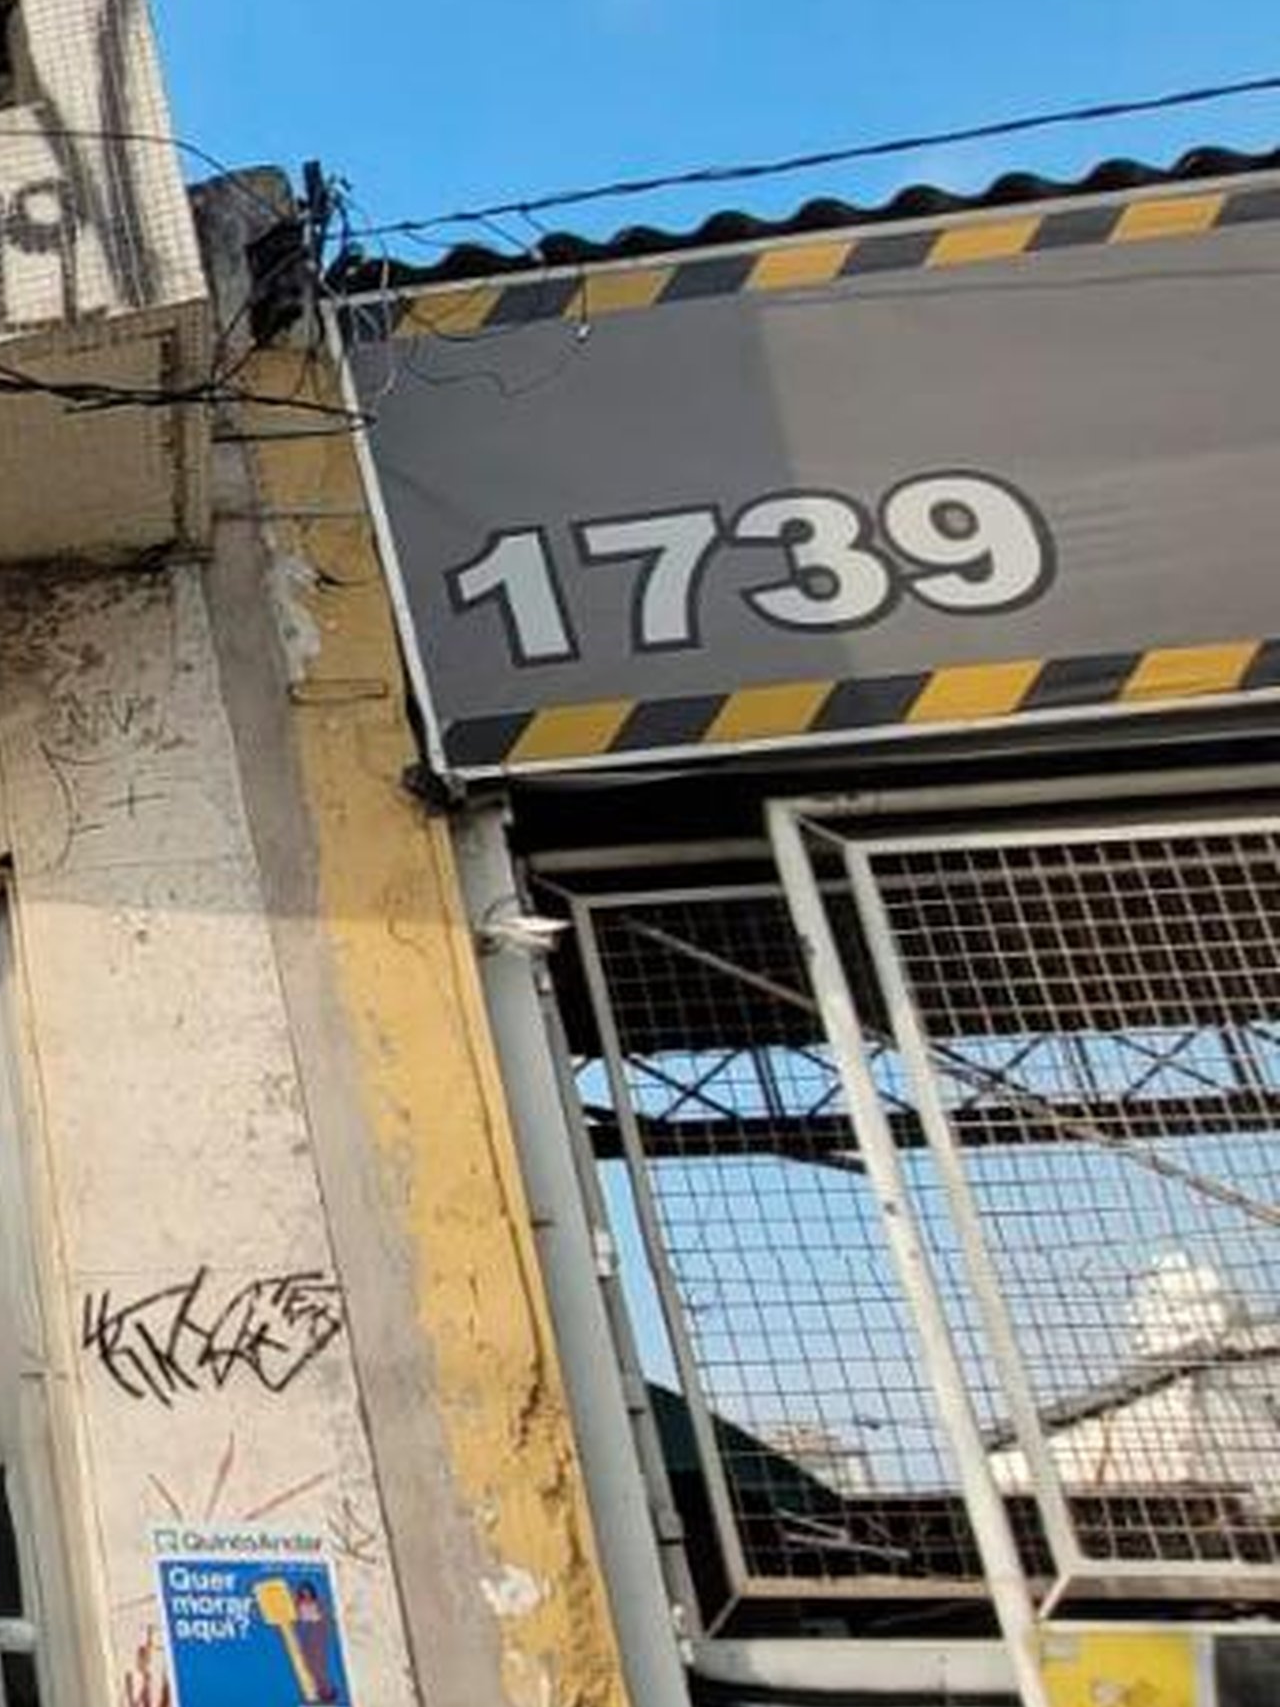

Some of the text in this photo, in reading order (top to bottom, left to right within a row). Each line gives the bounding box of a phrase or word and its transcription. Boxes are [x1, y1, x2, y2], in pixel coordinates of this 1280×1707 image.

[448, 469, 1053, 668] 1739
[168, 1566, 237, 1592] Quer
[172, 1596, 253, 1616] morar
[175, 1619, 251, 1643] aqui?
